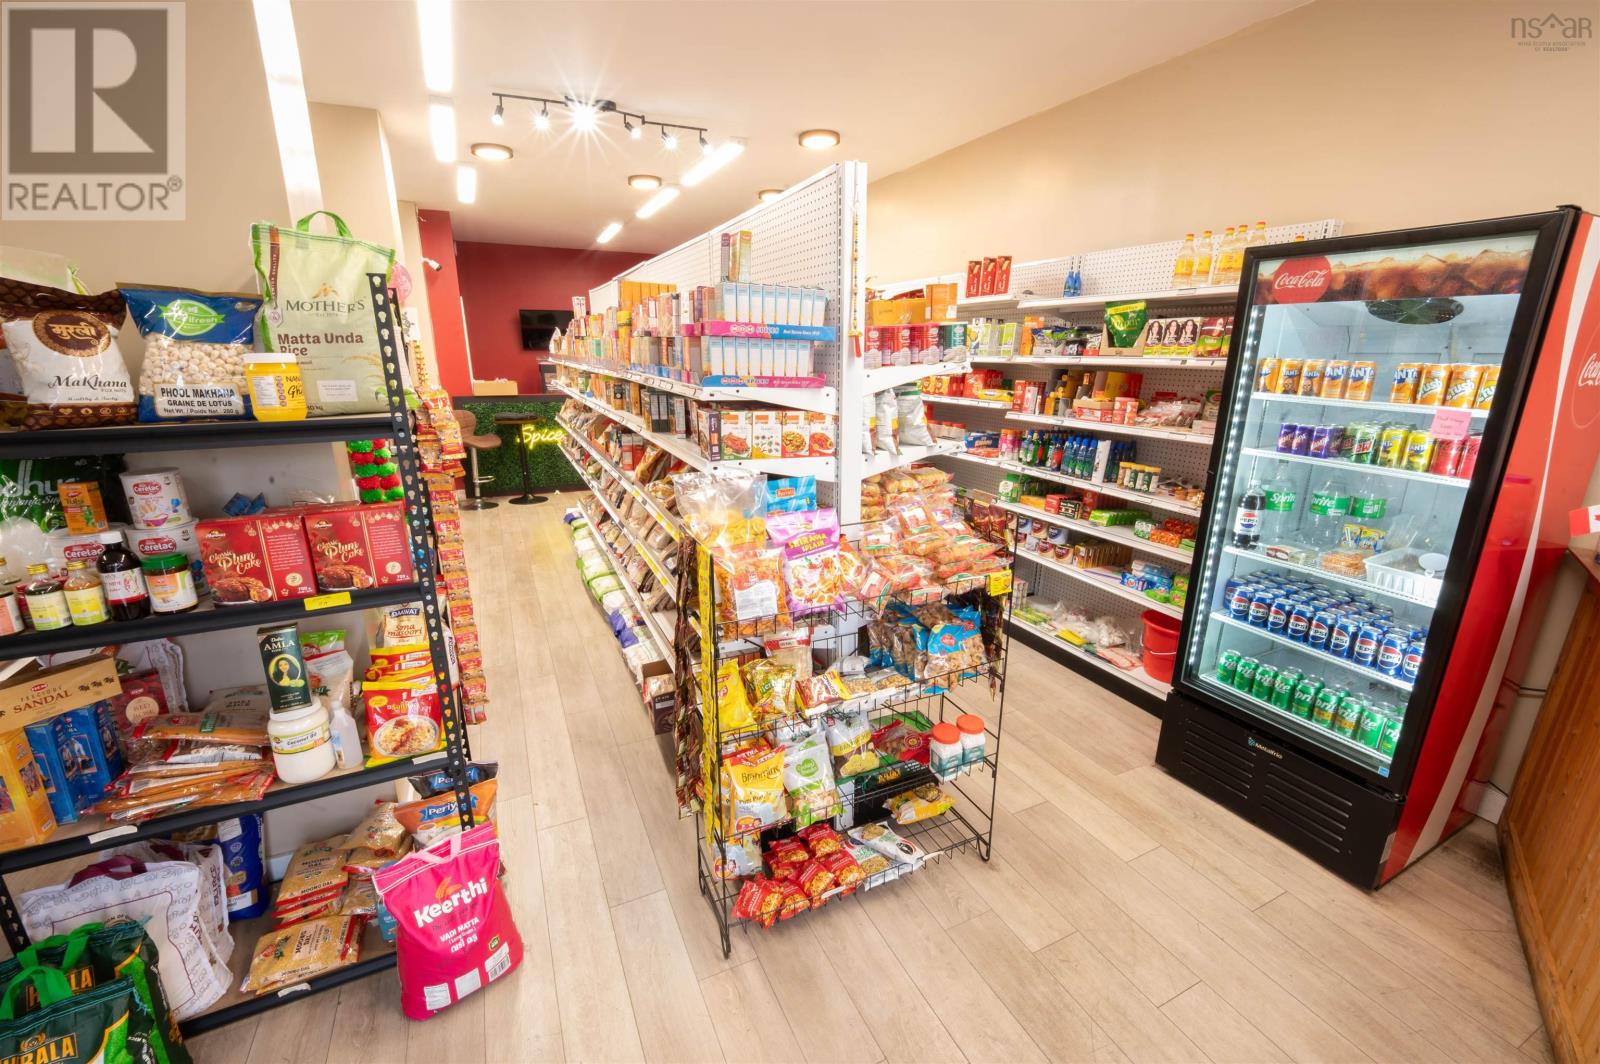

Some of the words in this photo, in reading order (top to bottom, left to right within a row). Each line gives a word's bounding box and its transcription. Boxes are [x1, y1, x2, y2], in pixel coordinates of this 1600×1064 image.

[1274, 268, 1330, 290] Coca-Cola
[277, 333, 322, 345] Matta
[324, 332, 364, 344] Unda
[280, 345, 308, 356] Rice
[160, 387, 191, 398] PHOOL
[192, 387, 236, 398] MAKHANA
[167, 399, 196, 407] GRAINE
[521, 426, 564, 449] Spice
[133, 483, 160, 494] Cerelac
[64, 547, 104, 559] Cerelac
[139, 541, 173, 552] Cerelac
[324, 540, 360, 560] Plum
[218, 551, 256, 572] Plum
[341, 548, 365, 563] Cake
[236, 558, 262, 575] Cake
[264, 640, 296, 652] AMLA
[13, 690, 73, 714] SANDAL
[286, 736, 309, 746] Coconut
[428, 800, 459, 816] Periy
[413, 877, 488, 929] Keerthi
[439, 928, 458, 943] VADI
[457, 916, 481, 933] MATTA
